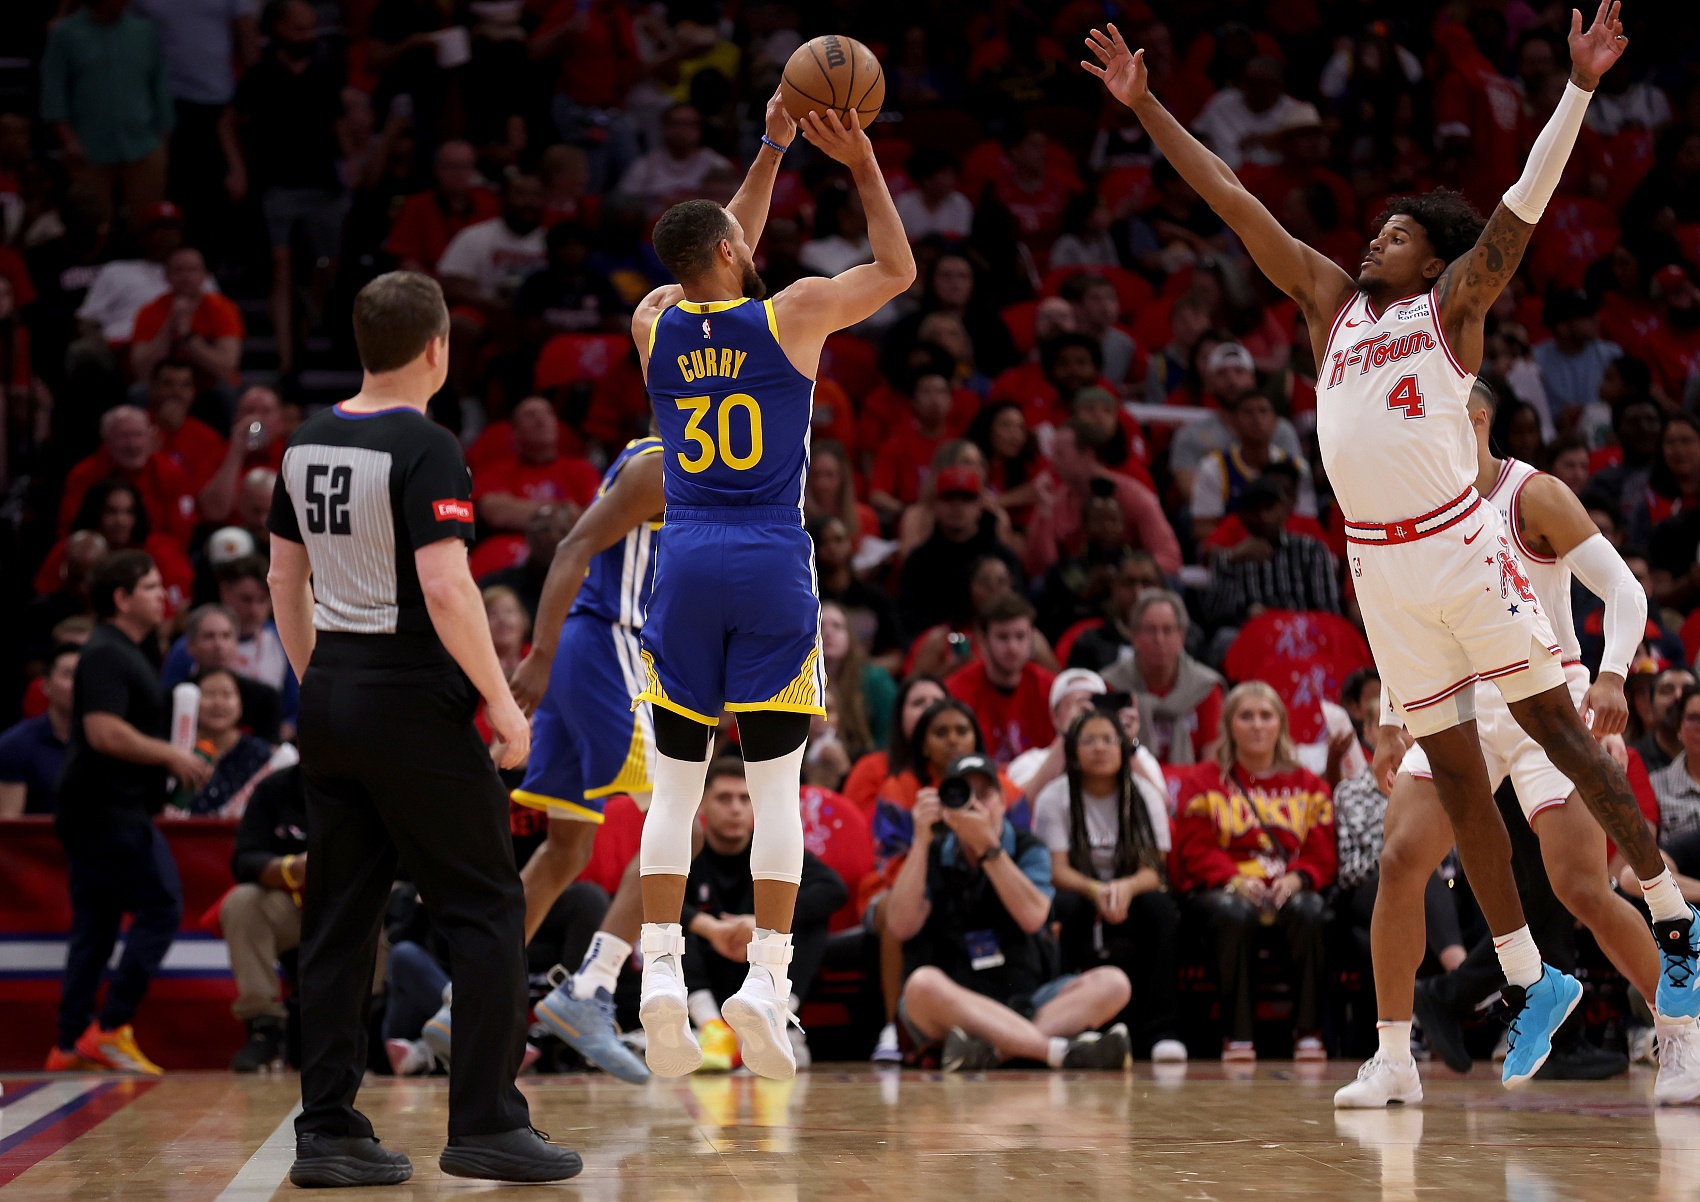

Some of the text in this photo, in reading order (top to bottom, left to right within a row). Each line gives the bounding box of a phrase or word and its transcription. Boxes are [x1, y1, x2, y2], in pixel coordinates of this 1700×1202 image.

[821, 35, 846, 70] Wil
[1397, 310, 1430, 321] karma
[1399, 303, 1428, 315] credit
[677, 347, 748, 383] CURRY
[1327, 330, 1437, 390] H-Town
[1386, 374, 1426, 420] 4
[675, 393, 763, 474] 30
[305, 464, 352, 535] 52
